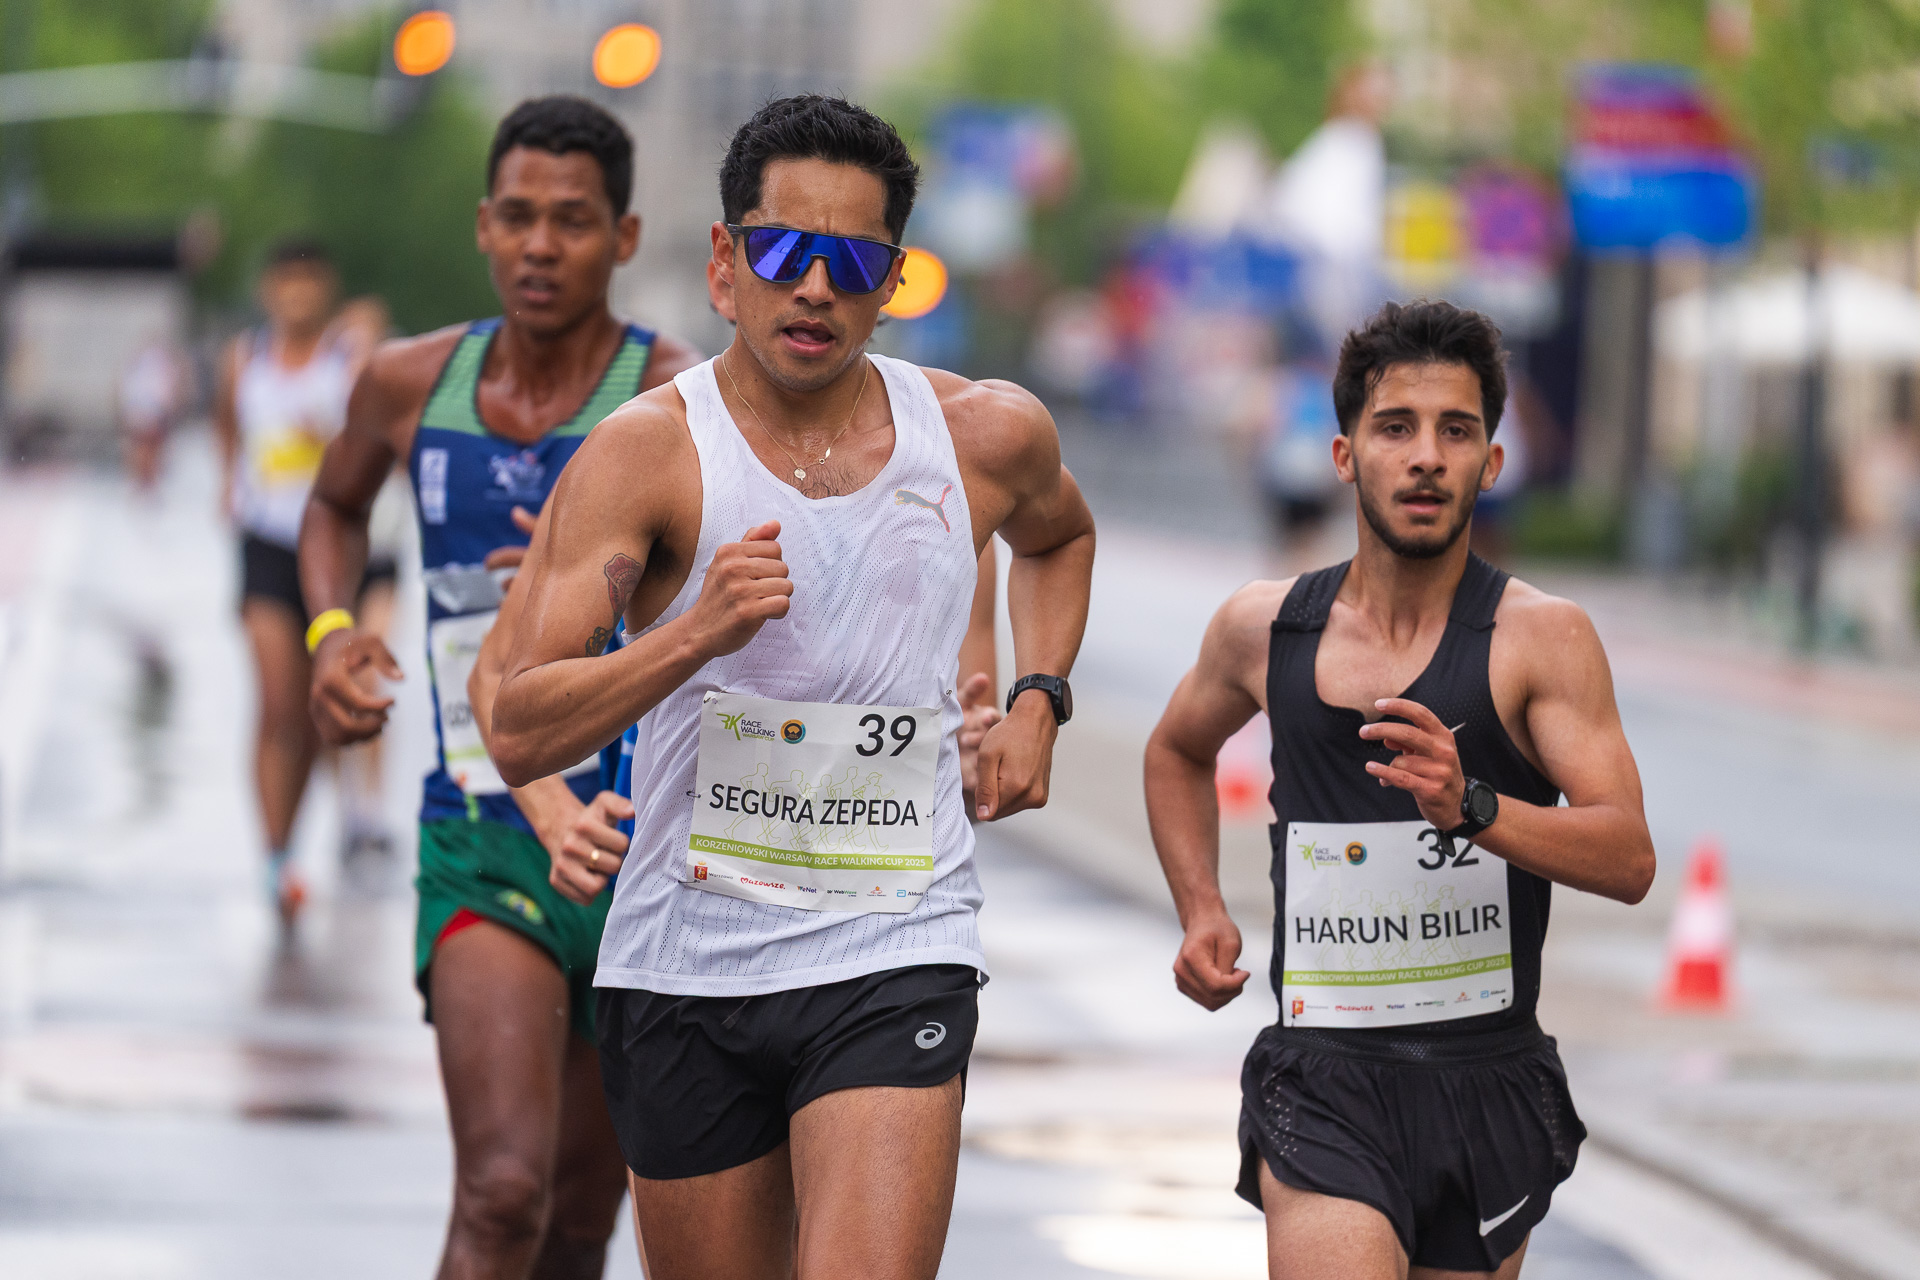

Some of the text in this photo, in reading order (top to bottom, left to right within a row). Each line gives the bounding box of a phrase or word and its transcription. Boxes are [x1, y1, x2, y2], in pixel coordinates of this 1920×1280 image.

[740, 726, 776, 738] WALKING
[741, 719, 762, 729] RACE
[855, 713, 917, 757] 39
[709, 783, 919, 826] SEGURA ZEPEDA
[695, 838, 926, 867] KORZENIOWSKI WARSAW RACE WALKING CUP 2025
[1295, 904, 1502, 944] HARUN BILIR
[1355, 971, 1397, 982] WARSAW
[1397, 969, 1421, 979] RACE
[1423, 965, 1466, 977] WALKING
[1466, 961, 1484, 971] CUP
[1485, 957, 1506, 968] 2025
